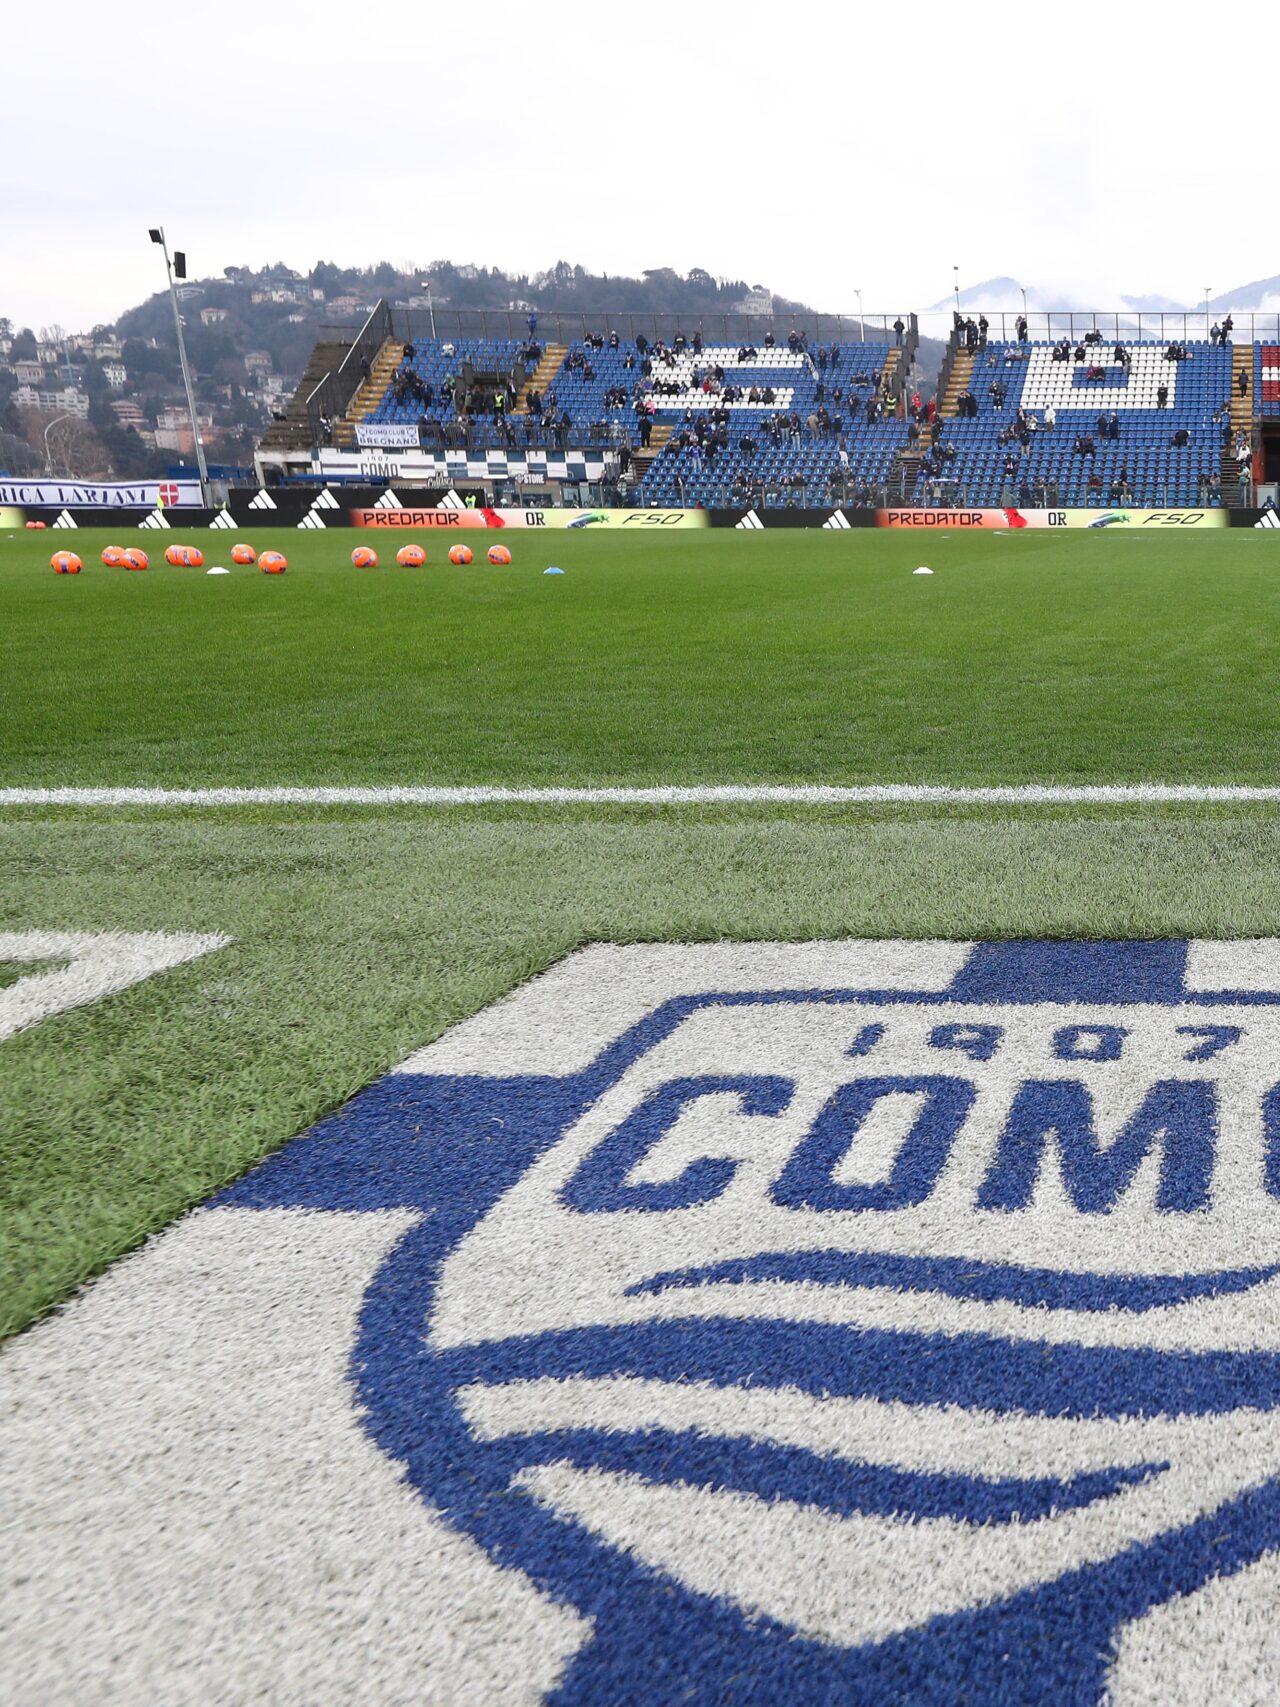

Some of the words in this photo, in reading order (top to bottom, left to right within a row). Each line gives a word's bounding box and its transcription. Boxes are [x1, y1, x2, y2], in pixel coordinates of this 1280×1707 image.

[361, 463, 399, 477] COMO
[523, 473, 545, 485] STORE
[59, 488, 146, 504] LARIANI
[364, 513, 460, 525] PREDATOR
[526, 512, 546, 525] OR
[888, 513, 983, 525] PREDATOR
[1048, 512, 1067, 525] OR
[846, 1023, 1242, 1061] 1907
